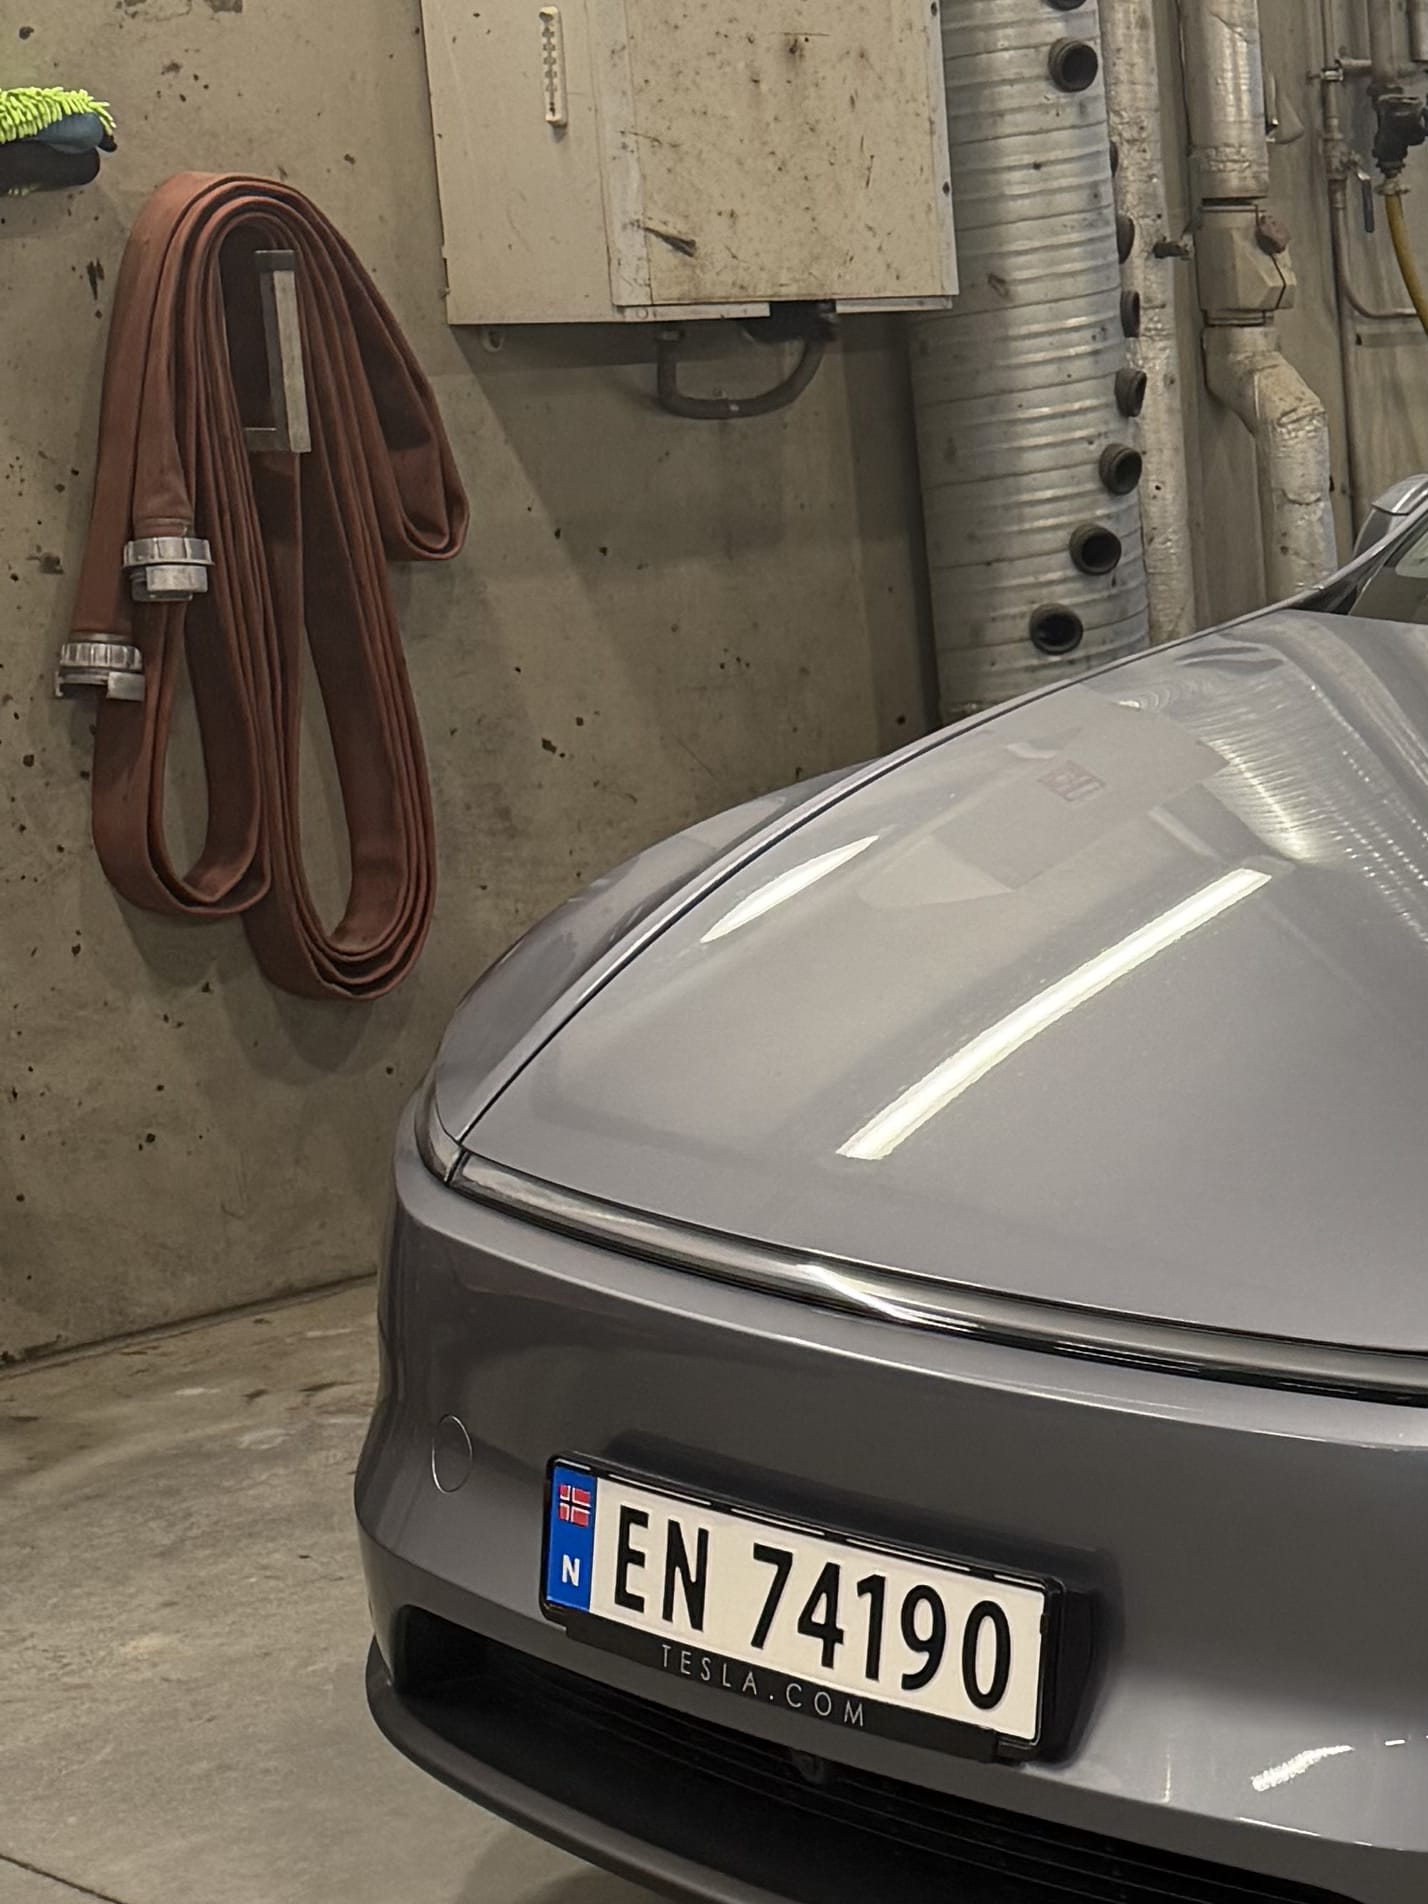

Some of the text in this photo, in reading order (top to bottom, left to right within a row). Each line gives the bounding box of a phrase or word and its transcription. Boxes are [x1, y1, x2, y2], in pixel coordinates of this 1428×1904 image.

[561, 1553, 581, 1588] N
[614, 1504, 1011, 1710] EN 74190
[661, 1644, 865, 1727] TESLA.COM
